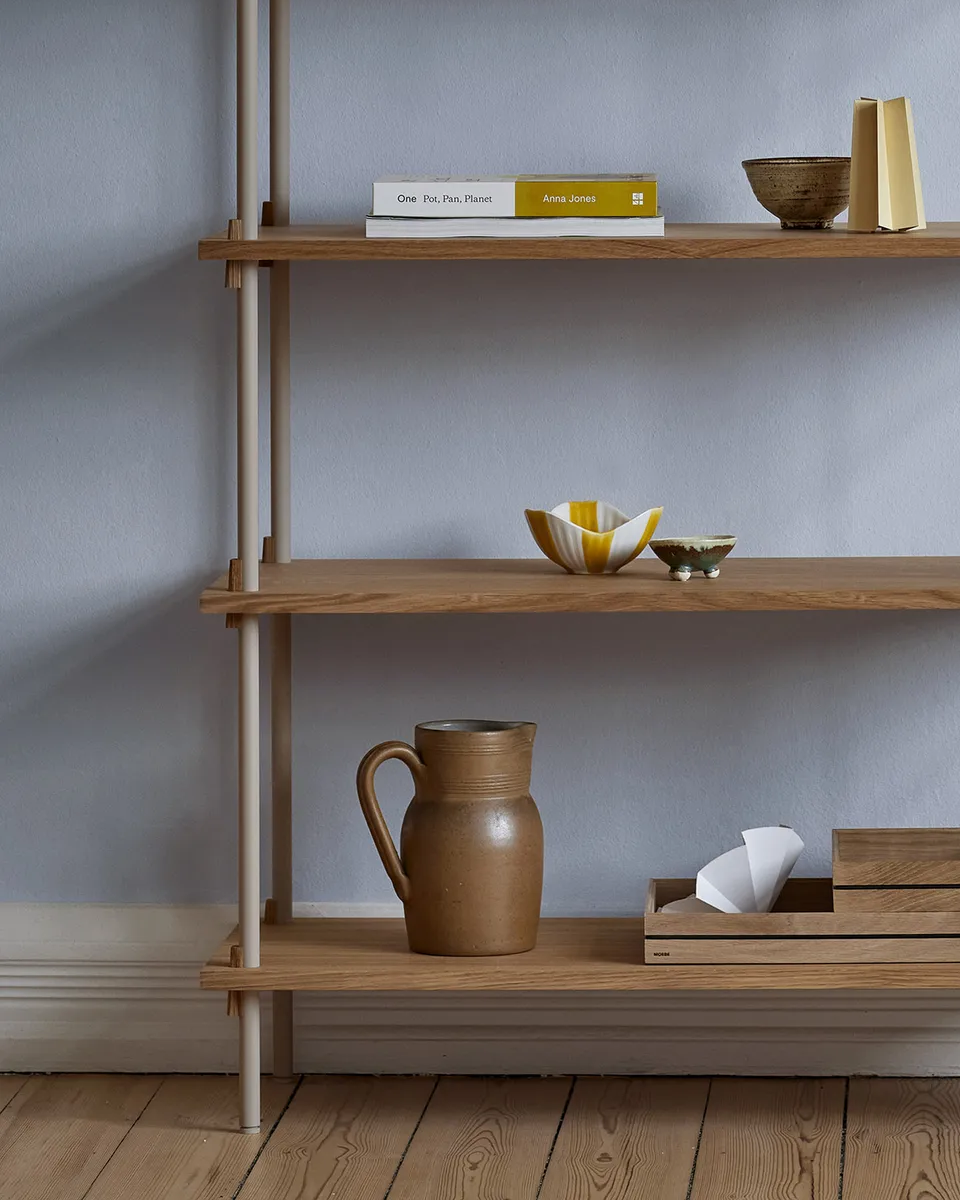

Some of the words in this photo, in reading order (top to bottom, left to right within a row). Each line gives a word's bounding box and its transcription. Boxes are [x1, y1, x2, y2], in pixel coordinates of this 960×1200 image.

[397, 194, 417, 203] One
[423, 194, 441, 204] Pot,
[443, 194, 462, 204] Pan,
[464, 194, 493, 203] Planet
[542, 194, 566, 203] Anna
[568, 194, 596, 203] Jones
